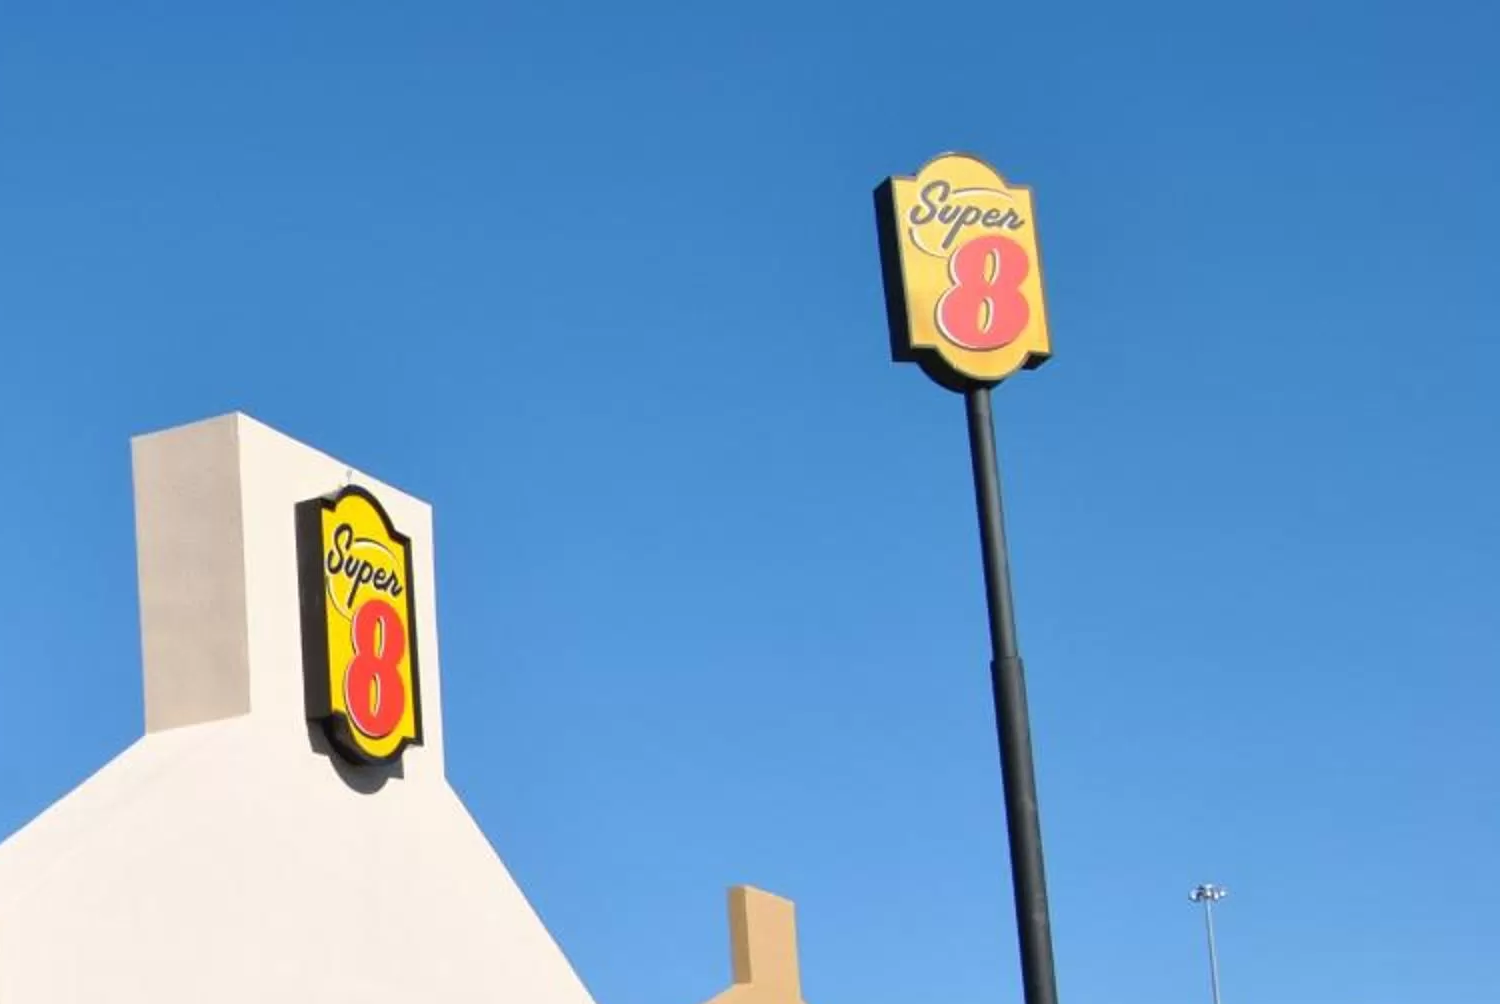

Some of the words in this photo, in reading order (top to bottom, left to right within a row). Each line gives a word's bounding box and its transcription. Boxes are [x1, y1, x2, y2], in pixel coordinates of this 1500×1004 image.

[909, 180, 1025, 250] Super
[934, 234, 1031, 352] 8
[327, 523, 403, 608] Super
[343, 598, 406, 740] 8
